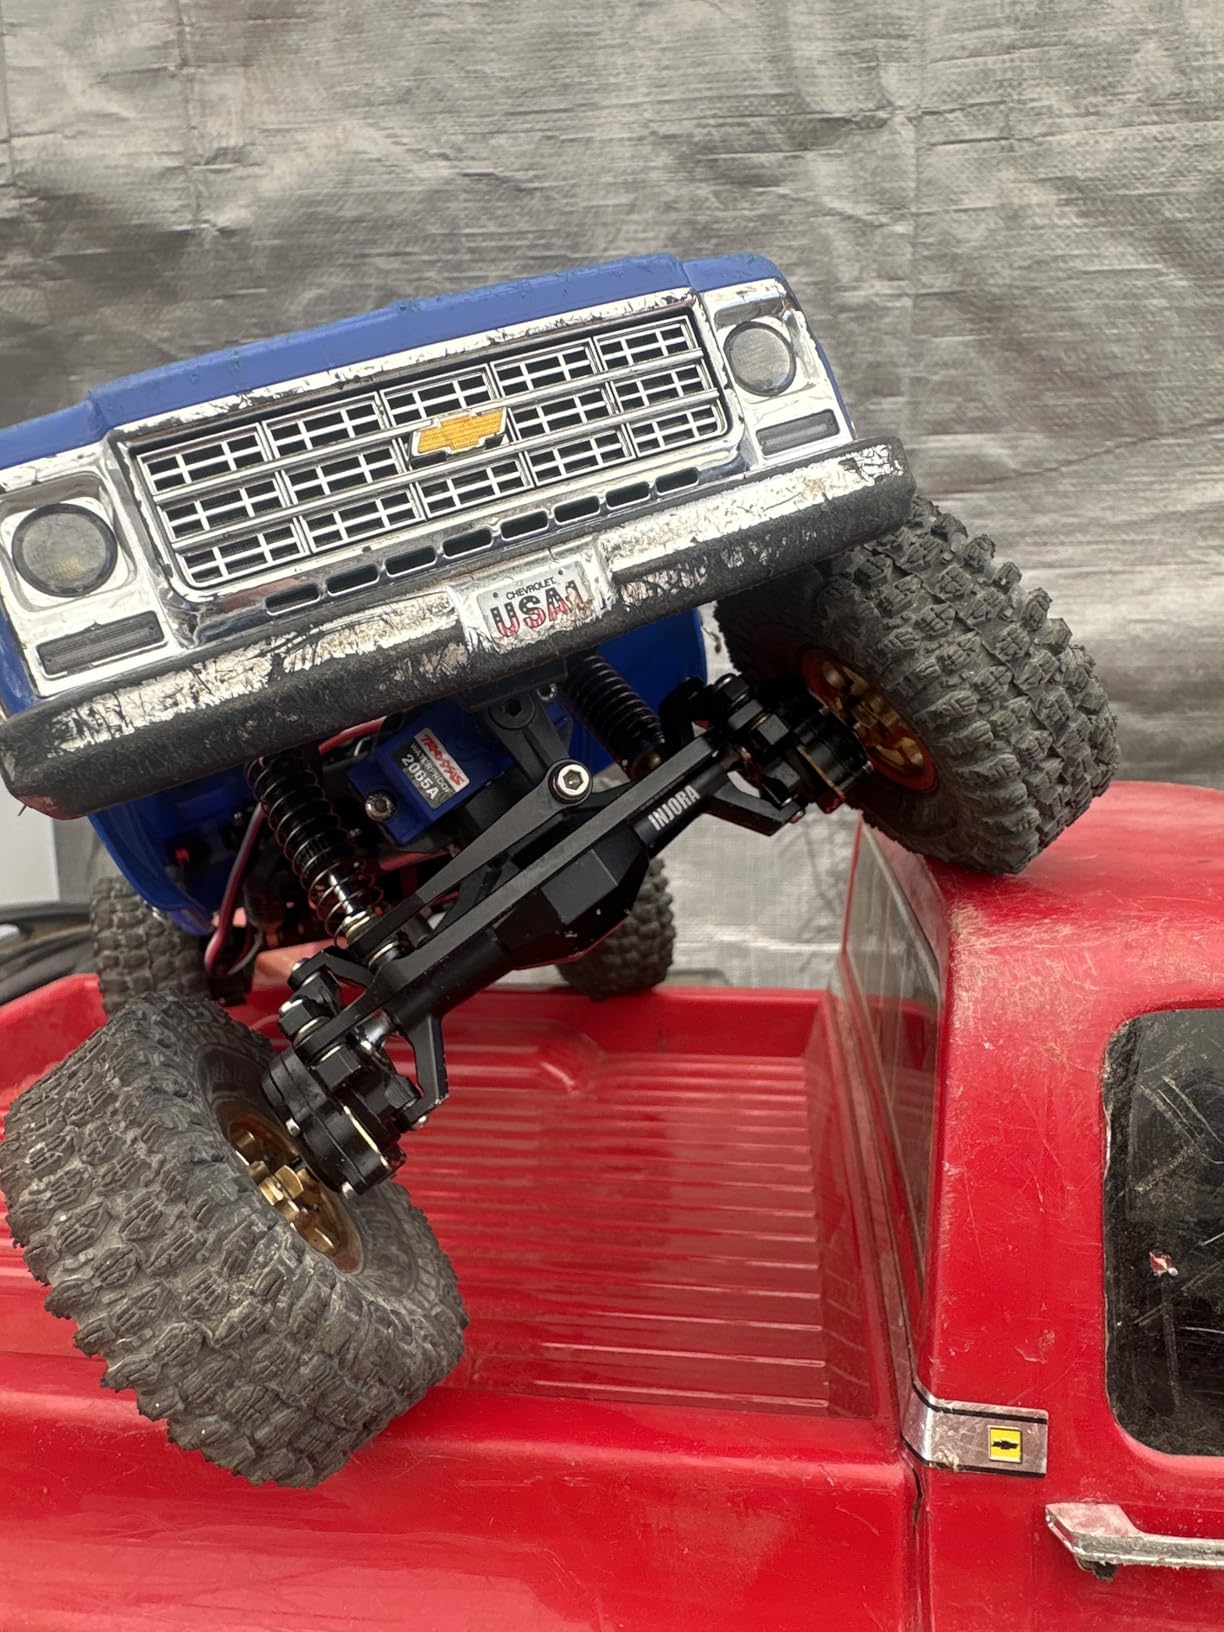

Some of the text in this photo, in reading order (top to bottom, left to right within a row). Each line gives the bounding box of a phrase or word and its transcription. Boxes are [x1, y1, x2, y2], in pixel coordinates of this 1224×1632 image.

[506, 577, 557, 600] CHEVROLET
[401, 754, 440, 800] 2065A
[410, 743, 452, 793] WATERPROOF
[421, 734, 465, 786] TRAXXAS
[648, 785, 701, 831] INJORA
